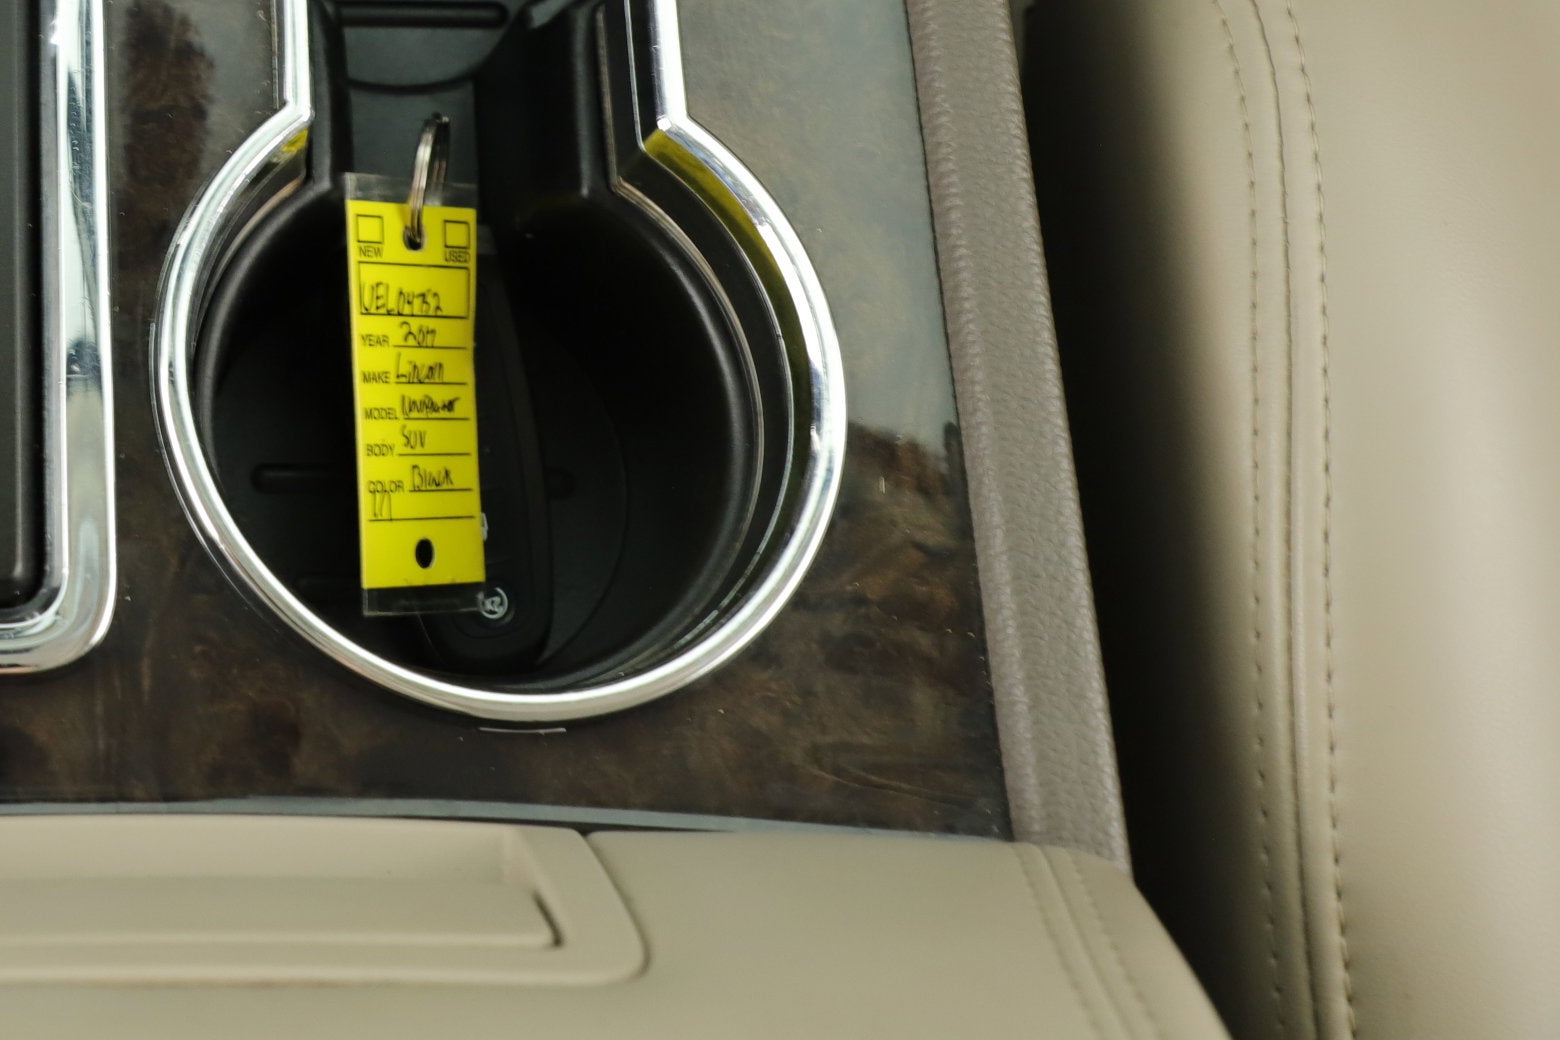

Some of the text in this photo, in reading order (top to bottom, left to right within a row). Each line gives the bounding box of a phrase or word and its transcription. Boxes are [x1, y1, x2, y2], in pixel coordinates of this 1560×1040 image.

[358, 246, 383, 259] NEW
[444, 250, 471, 264] USED
[361, 333, 390, 348] YEAR
[361, 370, 391, 384] MAKE
[364, 406, 399, 420] MODEL
[366, 443, 396, 457] BODY
[366, 480, 405, 494] COLOR
